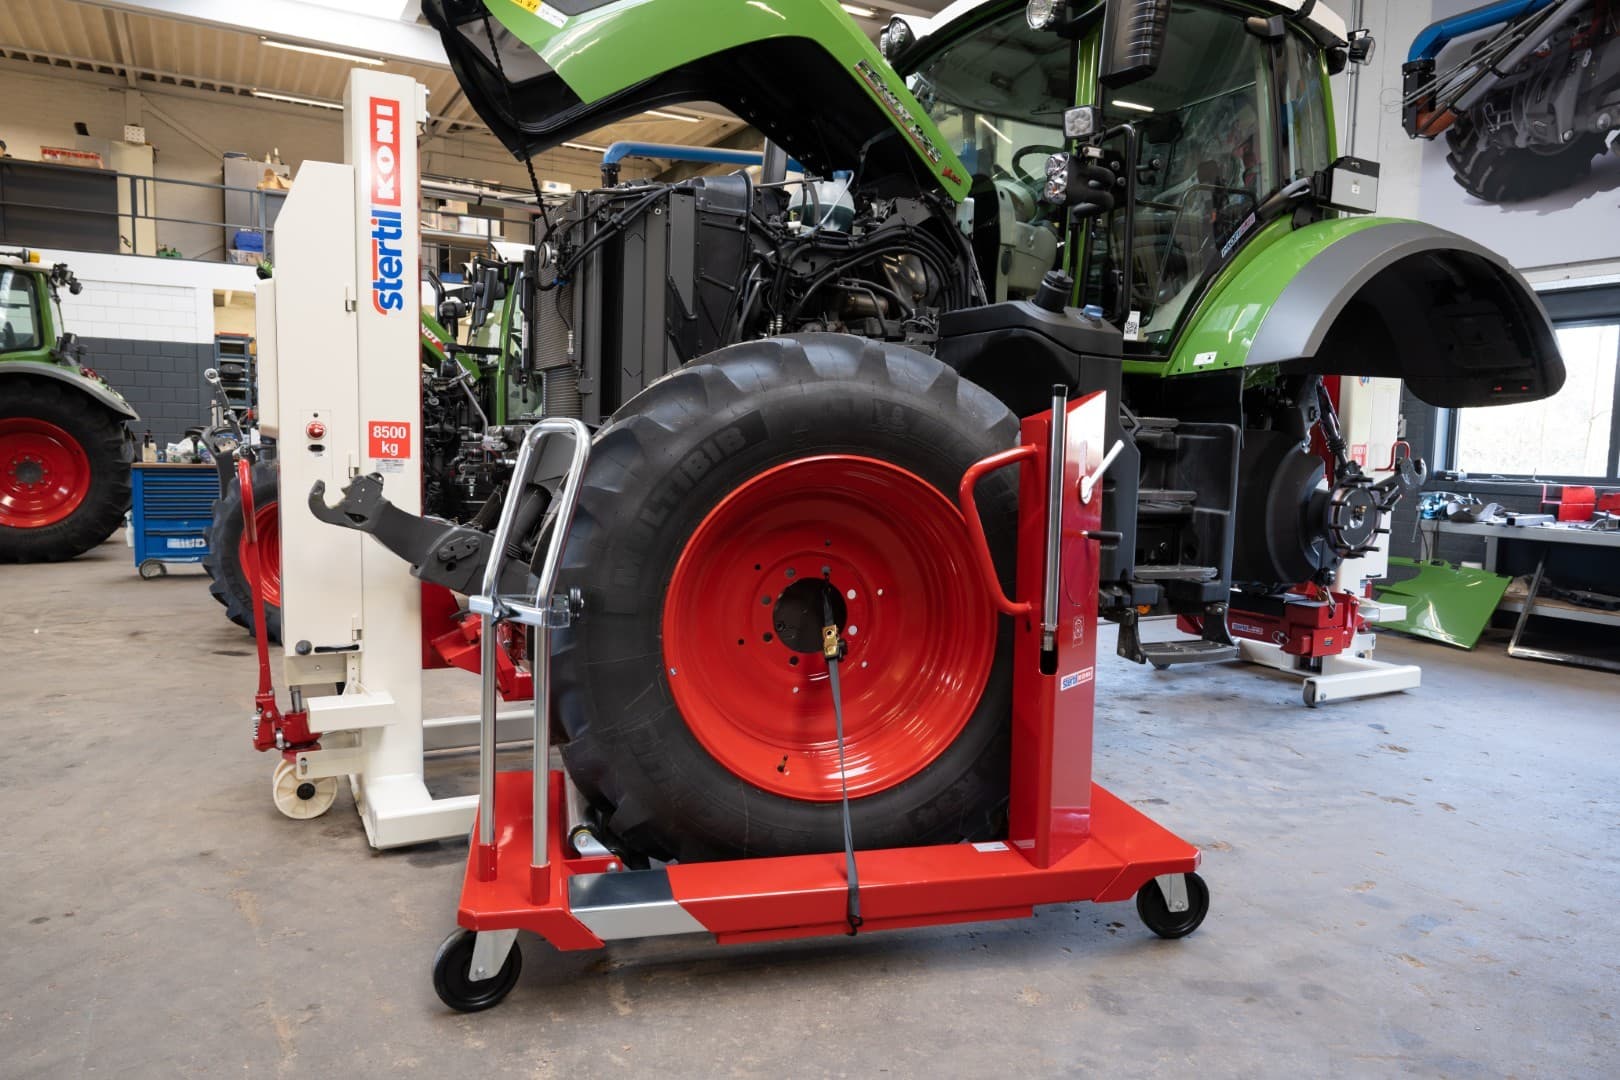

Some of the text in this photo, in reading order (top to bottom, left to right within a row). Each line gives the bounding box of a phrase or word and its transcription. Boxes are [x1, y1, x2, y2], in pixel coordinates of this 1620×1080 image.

[371, 104, 403, 314] stertil KONI
[373, 425, 407, 439] 8500
[381, 440, 399, 456] kg
